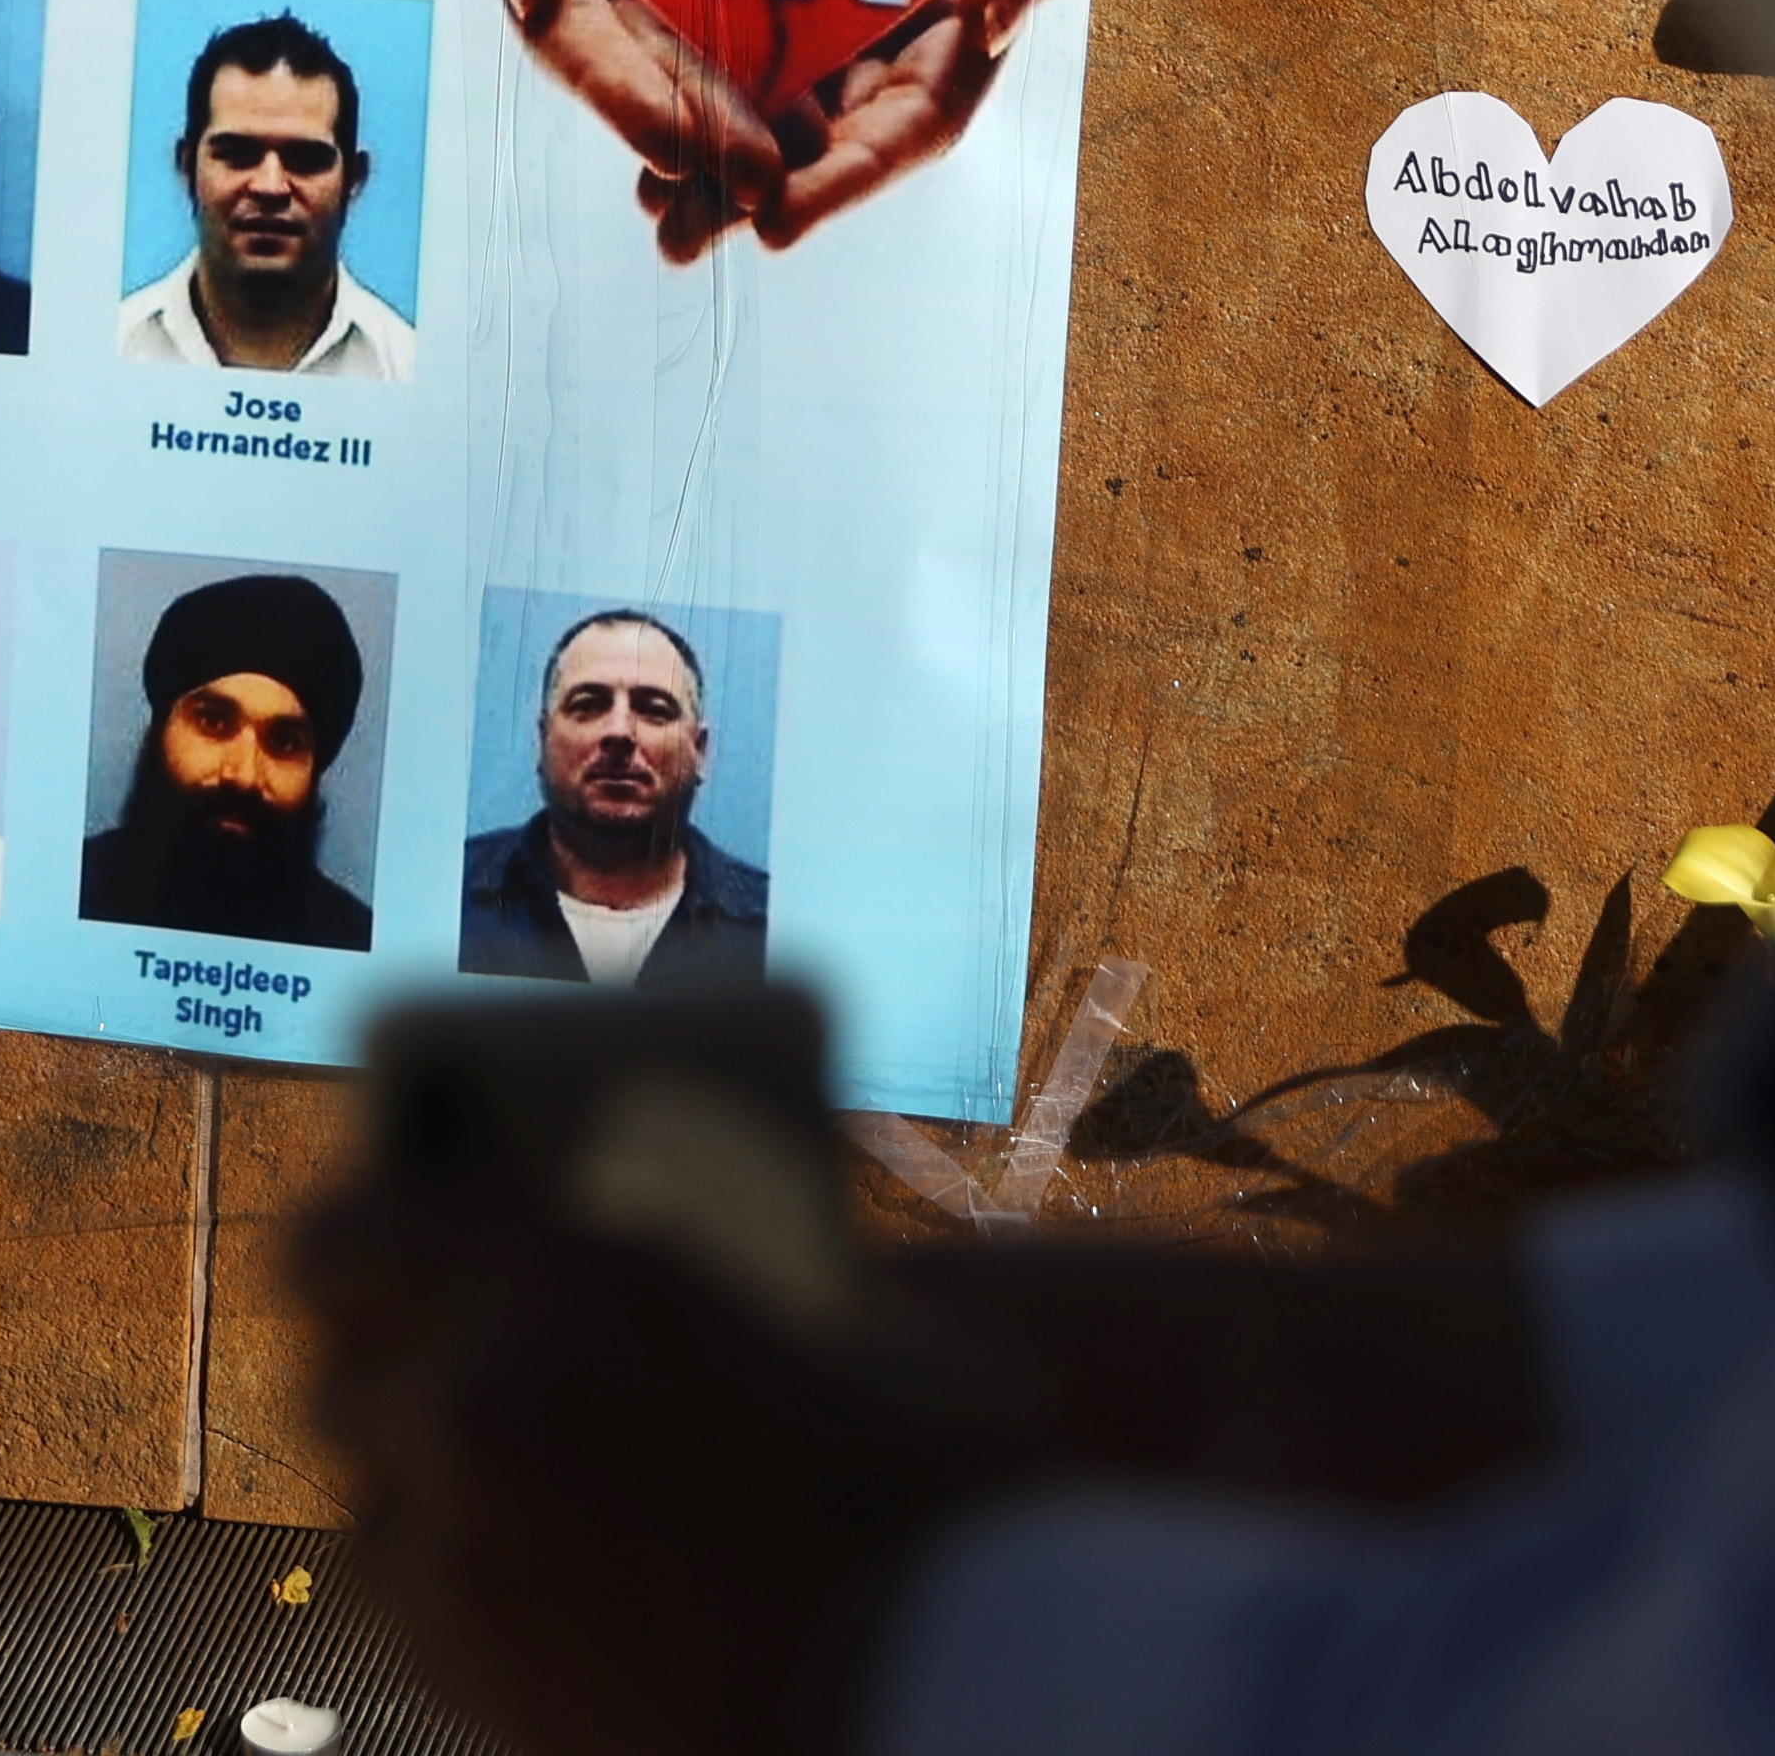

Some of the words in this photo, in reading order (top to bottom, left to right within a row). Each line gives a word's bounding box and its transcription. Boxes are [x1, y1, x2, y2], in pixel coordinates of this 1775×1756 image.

[224, 390, 302, 423] Jose
[150, 421, 331, 461] Hernandez
[339, 437, 372, 468] III
[134, 950, 312, 1004] Taptejdeep
[175, 996, 263, 1038] Singh
